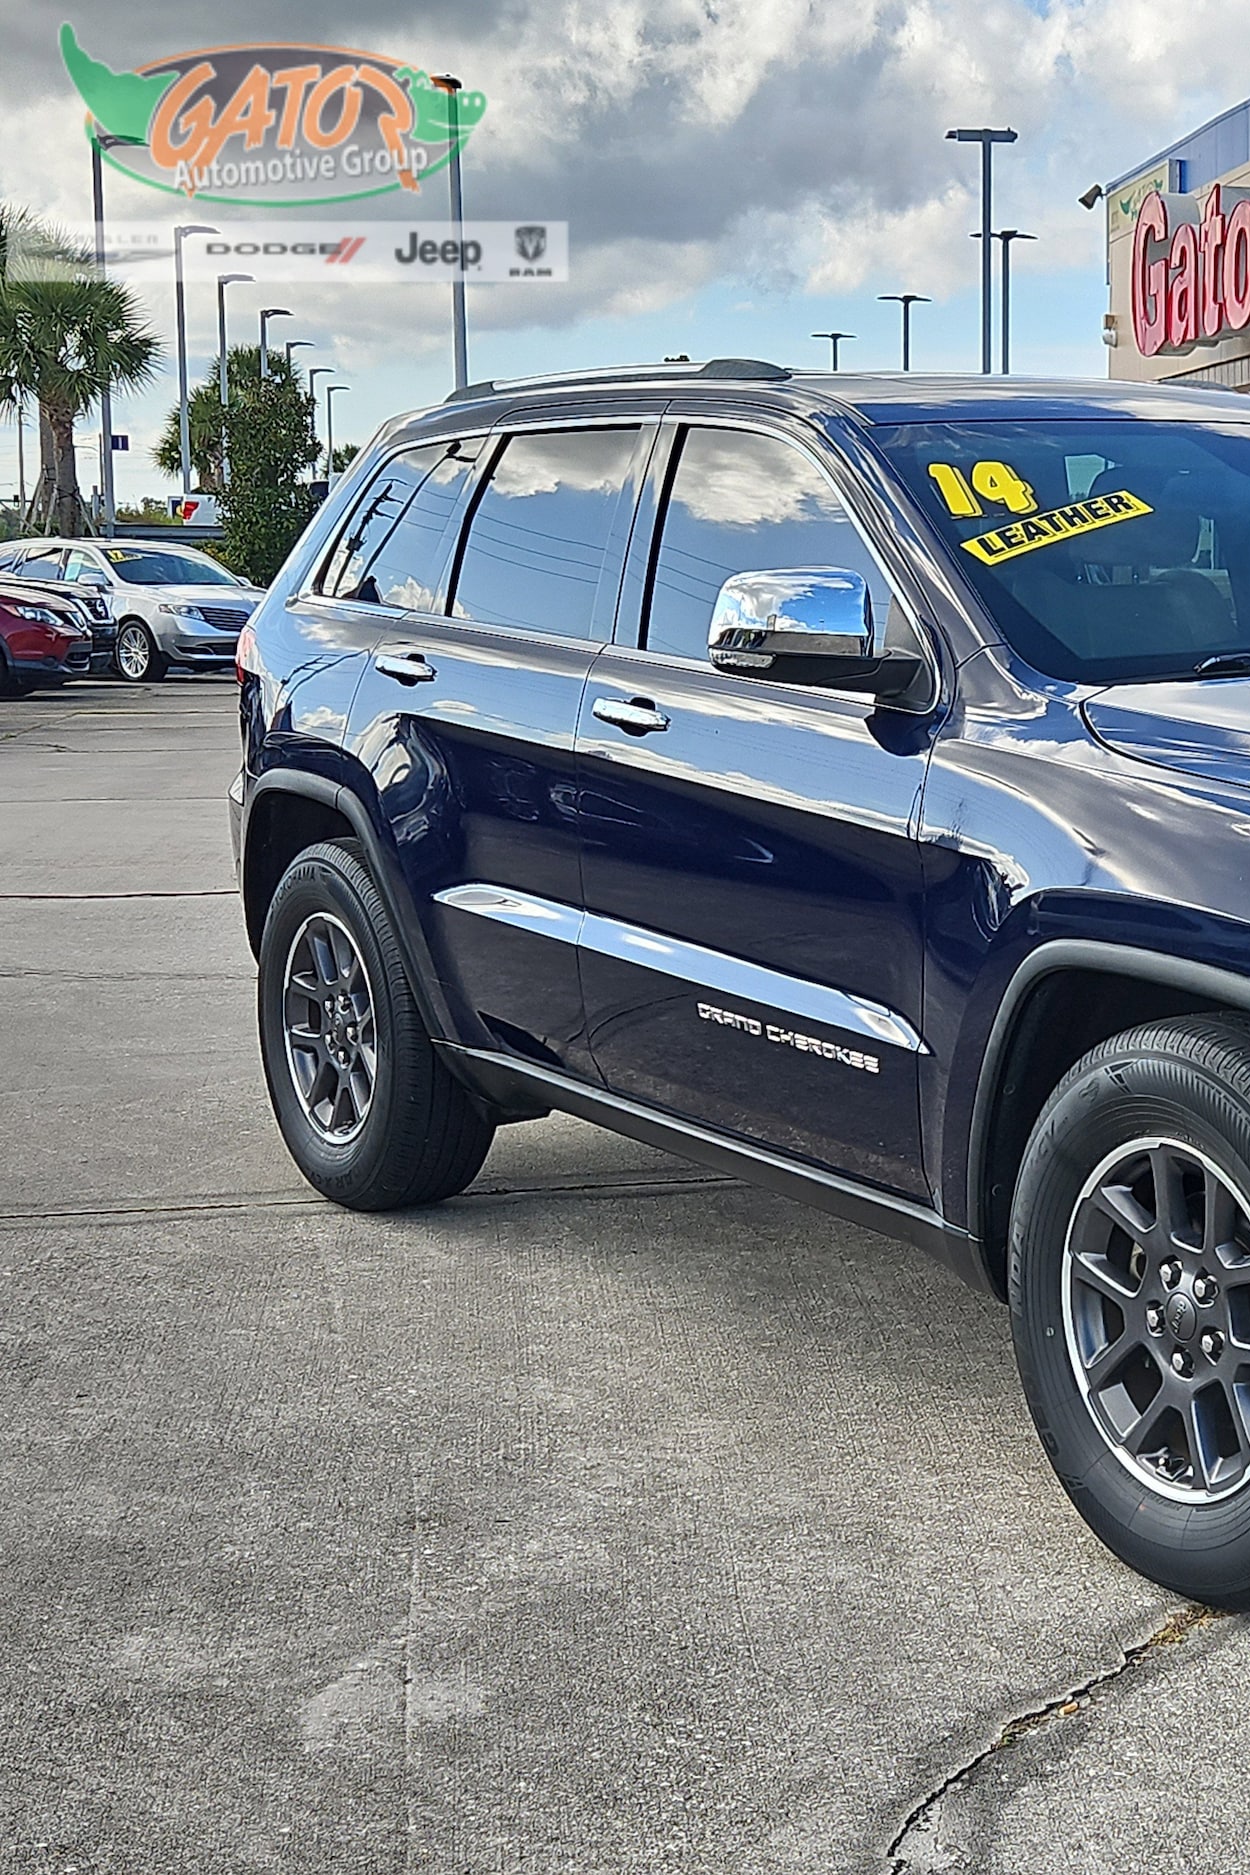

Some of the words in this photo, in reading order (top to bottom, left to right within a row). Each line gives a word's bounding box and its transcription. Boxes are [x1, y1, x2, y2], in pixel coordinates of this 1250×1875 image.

[928, 461, 1039, 517] 14
[976, 493, 1138, 557] LEATHER
[697, 1002, 762, 1036] GRAND
[765, 1024, 881, 1074] CHEROKEE
